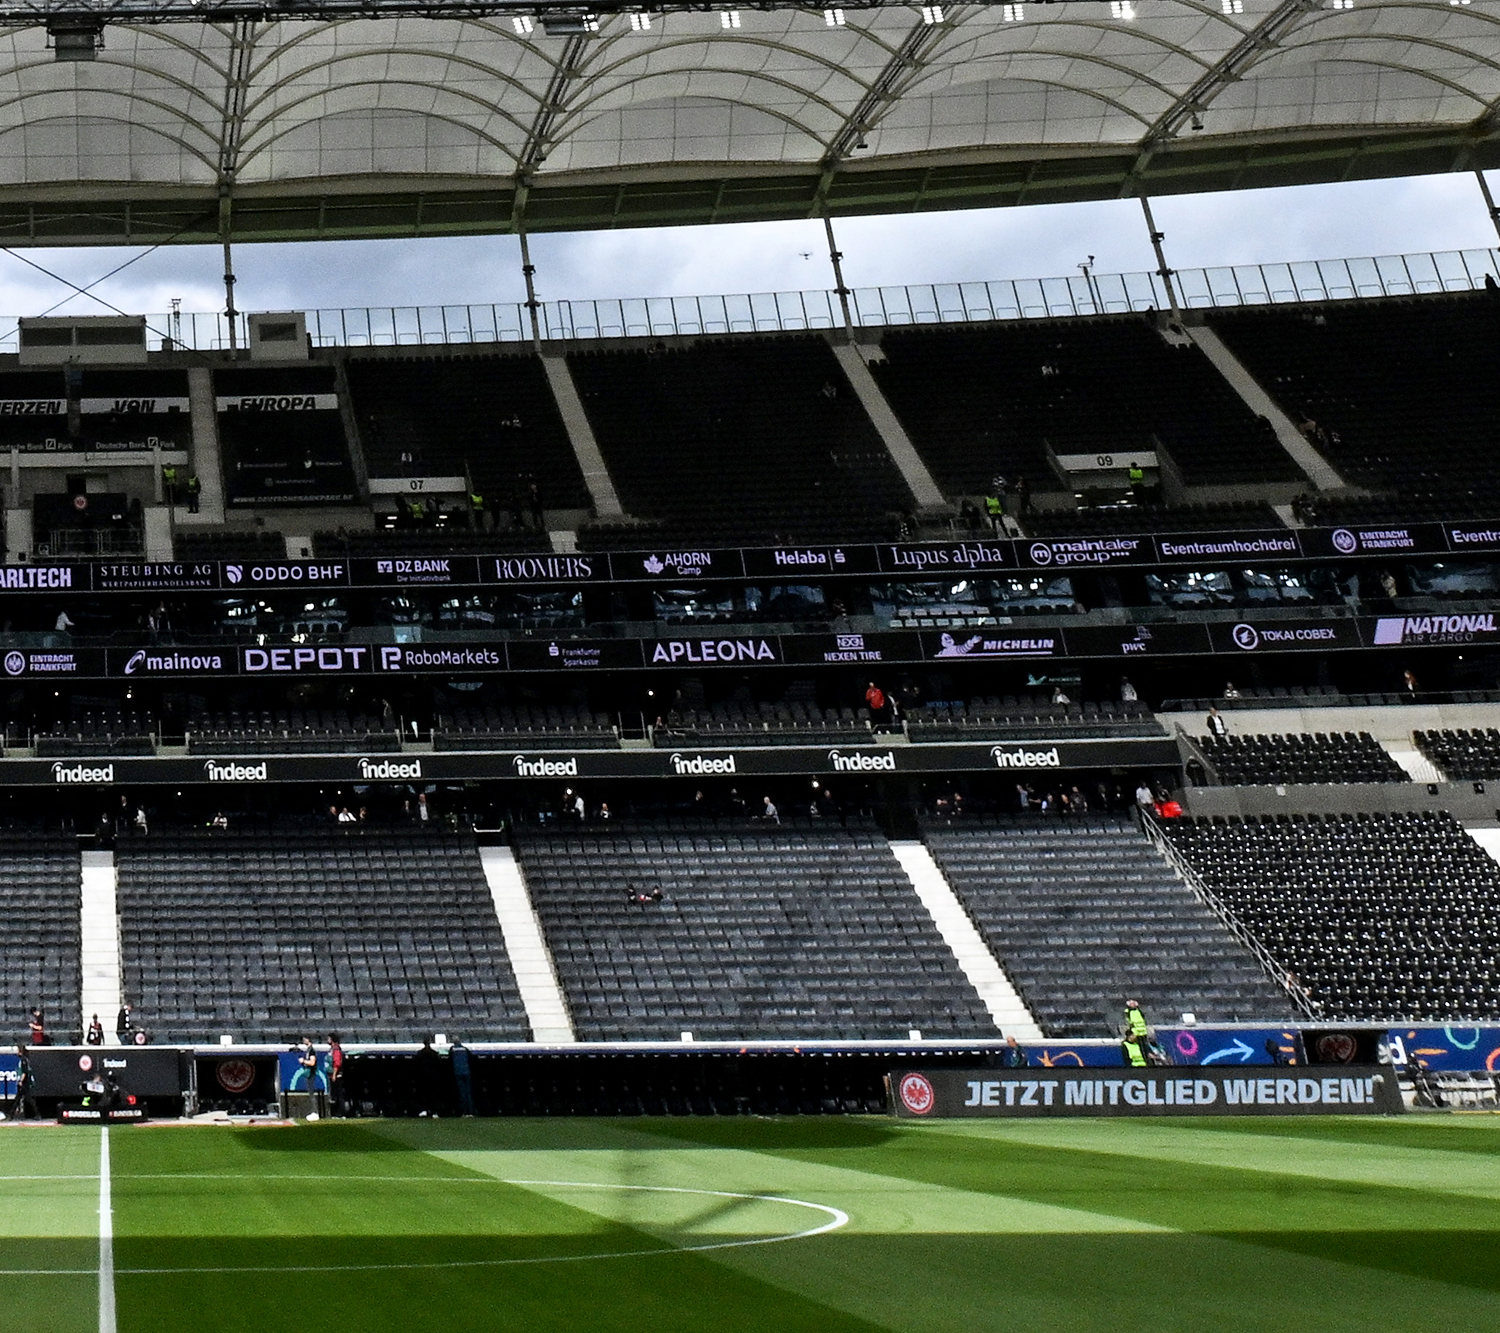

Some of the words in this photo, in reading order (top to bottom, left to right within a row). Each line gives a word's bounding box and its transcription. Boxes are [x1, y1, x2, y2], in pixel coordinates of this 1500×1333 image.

[113, 399, 156, 413] VON
[240, 397, 317, 411] EUROPA
[1097, 455, 1114, 466] 09
[409, 480, 424, 490] 07
[1359, 530, 1410, 542] EINTRACHT
[1360, 537, 1415, 549] FRANKFURT
[1051, 538, 1140, 552] maintaler
[1161, 536, 1297, 556] Eventraumhochdrei
[665, 552, 711, 566] AHORN
[775, 551, 826, 566] Helaba
[890, 545, 949, 570] Lupus
[953, 542, 1004, 569] alpha
[1055, 549, 1110, 565] group
[101, 564, 183, 577] STEUBING
[192, 564, 212, 576] AG
[251, 566, 303, 580] ODDO
[308, 564, 343, 579] BHF
[395, 561, 413, 574] DZ
[414, 560, 451, 573] BANK
[496, 557, 592, 579] ROOMERS
[676, 565, 702, 576] Camp
[1402, 613, 1498, 634] NATIONAL
[1261, 629, 1295, 642] TOKAI
[1296, 627, 1337, 641] COBEX
[1403, 635, 1424, 645] AIR
[1429, 632, 1474, 643] CARGO
[652, 640, 775, 664] APLEONA
[982, 638, 1055, 651] MICHELIN
[30, 654, 75, 662] EINTRACHT
[147, 652, 222, 671] mainova
[244, 647, 366, 671] DEPOT
[405, 648, 500, 666] RoboMarkets
[824, 651, 857, 662] NEXEN
[858, 650, 882, 661] TIRE
[30, 663, 77, 672] FRANKFURT
[670, 752, 735, 774] indeed
[828, 749, 895, 771] indeed
[990, 745, 1060, 768] indeed
[52, 761, 114, 783] indeed
[204, 759, 267, 781] indeed
[357, 757, 421, 779] indeed
[513, 755, 577, 777] indeed
[965, 1081, 1059, 1107] JETZT
[1064, 1080, 1220, 1106] MITGLIED
[1223, 1078, 1375, 1105] WERDEN!
